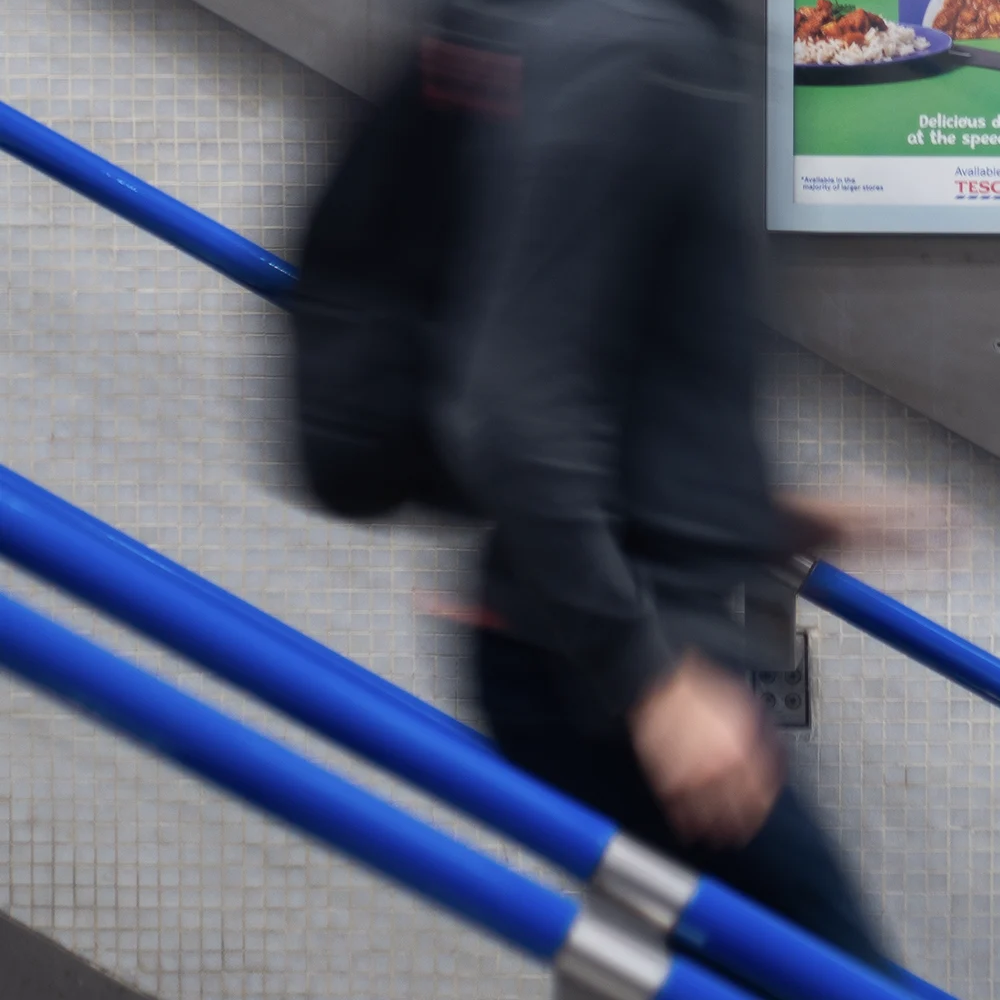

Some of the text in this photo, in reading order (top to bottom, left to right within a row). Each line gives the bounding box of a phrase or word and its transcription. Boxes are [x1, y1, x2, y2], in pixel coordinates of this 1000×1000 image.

[918, 113, 986, 129] Delicious
[907, 132, 924, 146] at
[930, 131, 956, 146] the
[835, 176, 843, 184] in
[844, 176, 856, 184] the
[802, 184, 831, 192] majority
[841, 184, 861, 193] larger
[862, 184, 884, 192] stores
